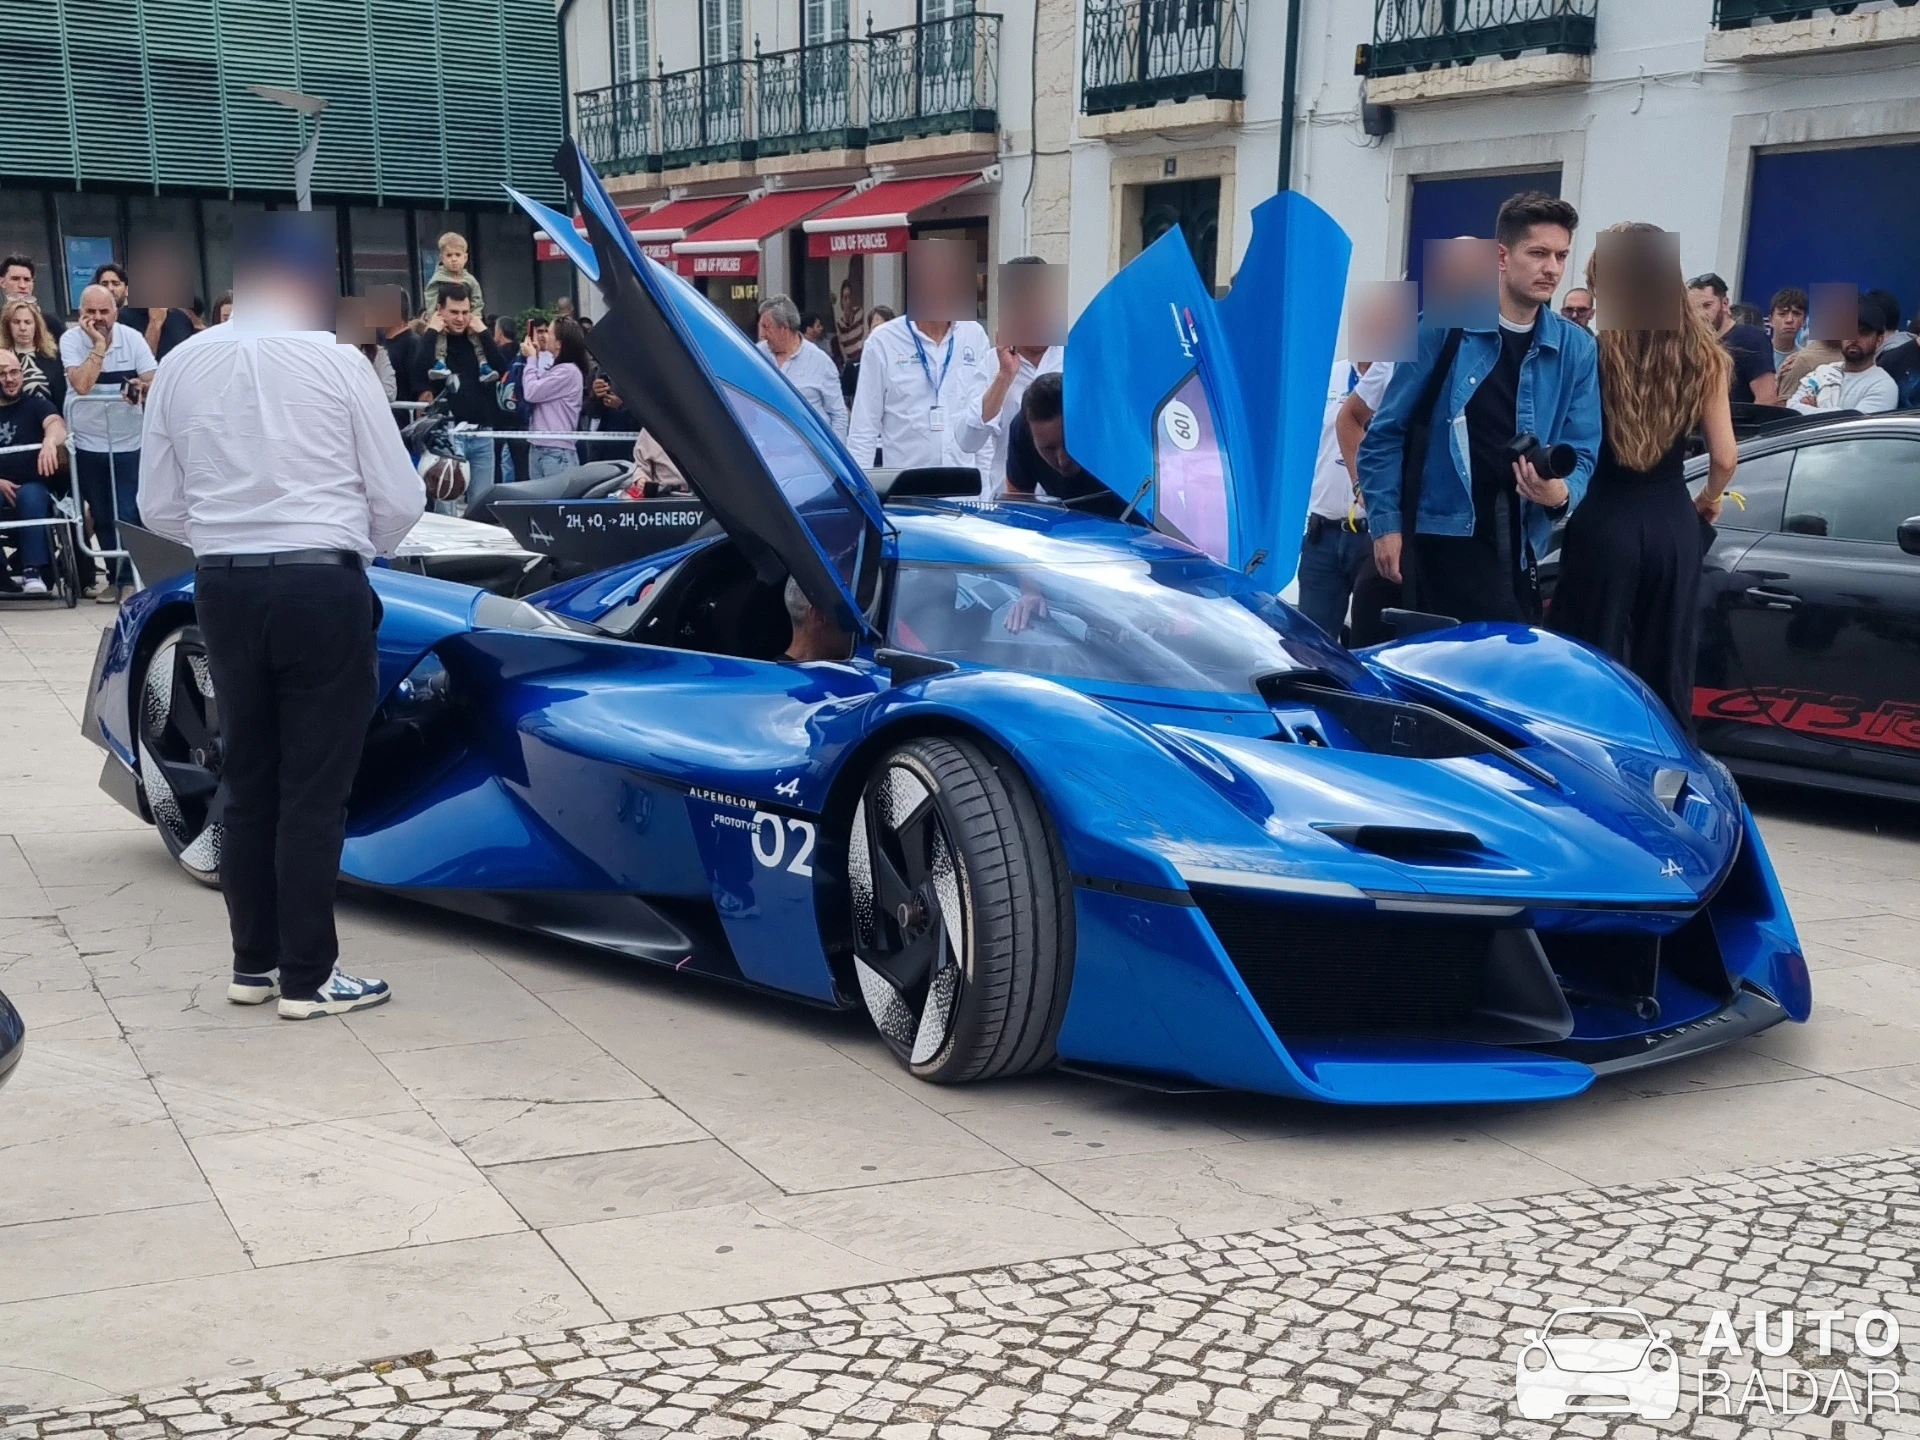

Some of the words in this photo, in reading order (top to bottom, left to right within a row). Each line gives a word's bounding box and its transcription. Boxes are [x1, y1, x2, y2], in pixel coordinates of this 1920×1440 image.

[830, 235, 847, 252] LION
[847, 234, 856, 250] OF
[1707, 687, 1862, 730] GT3
[689, 787, 757, 810] ALPENGLOW
[714, 813, 762, 834] PROTOTYPE
[752, 811, 816, 877] 02
[1645, 1014, 1732, 1045] ALPINE
